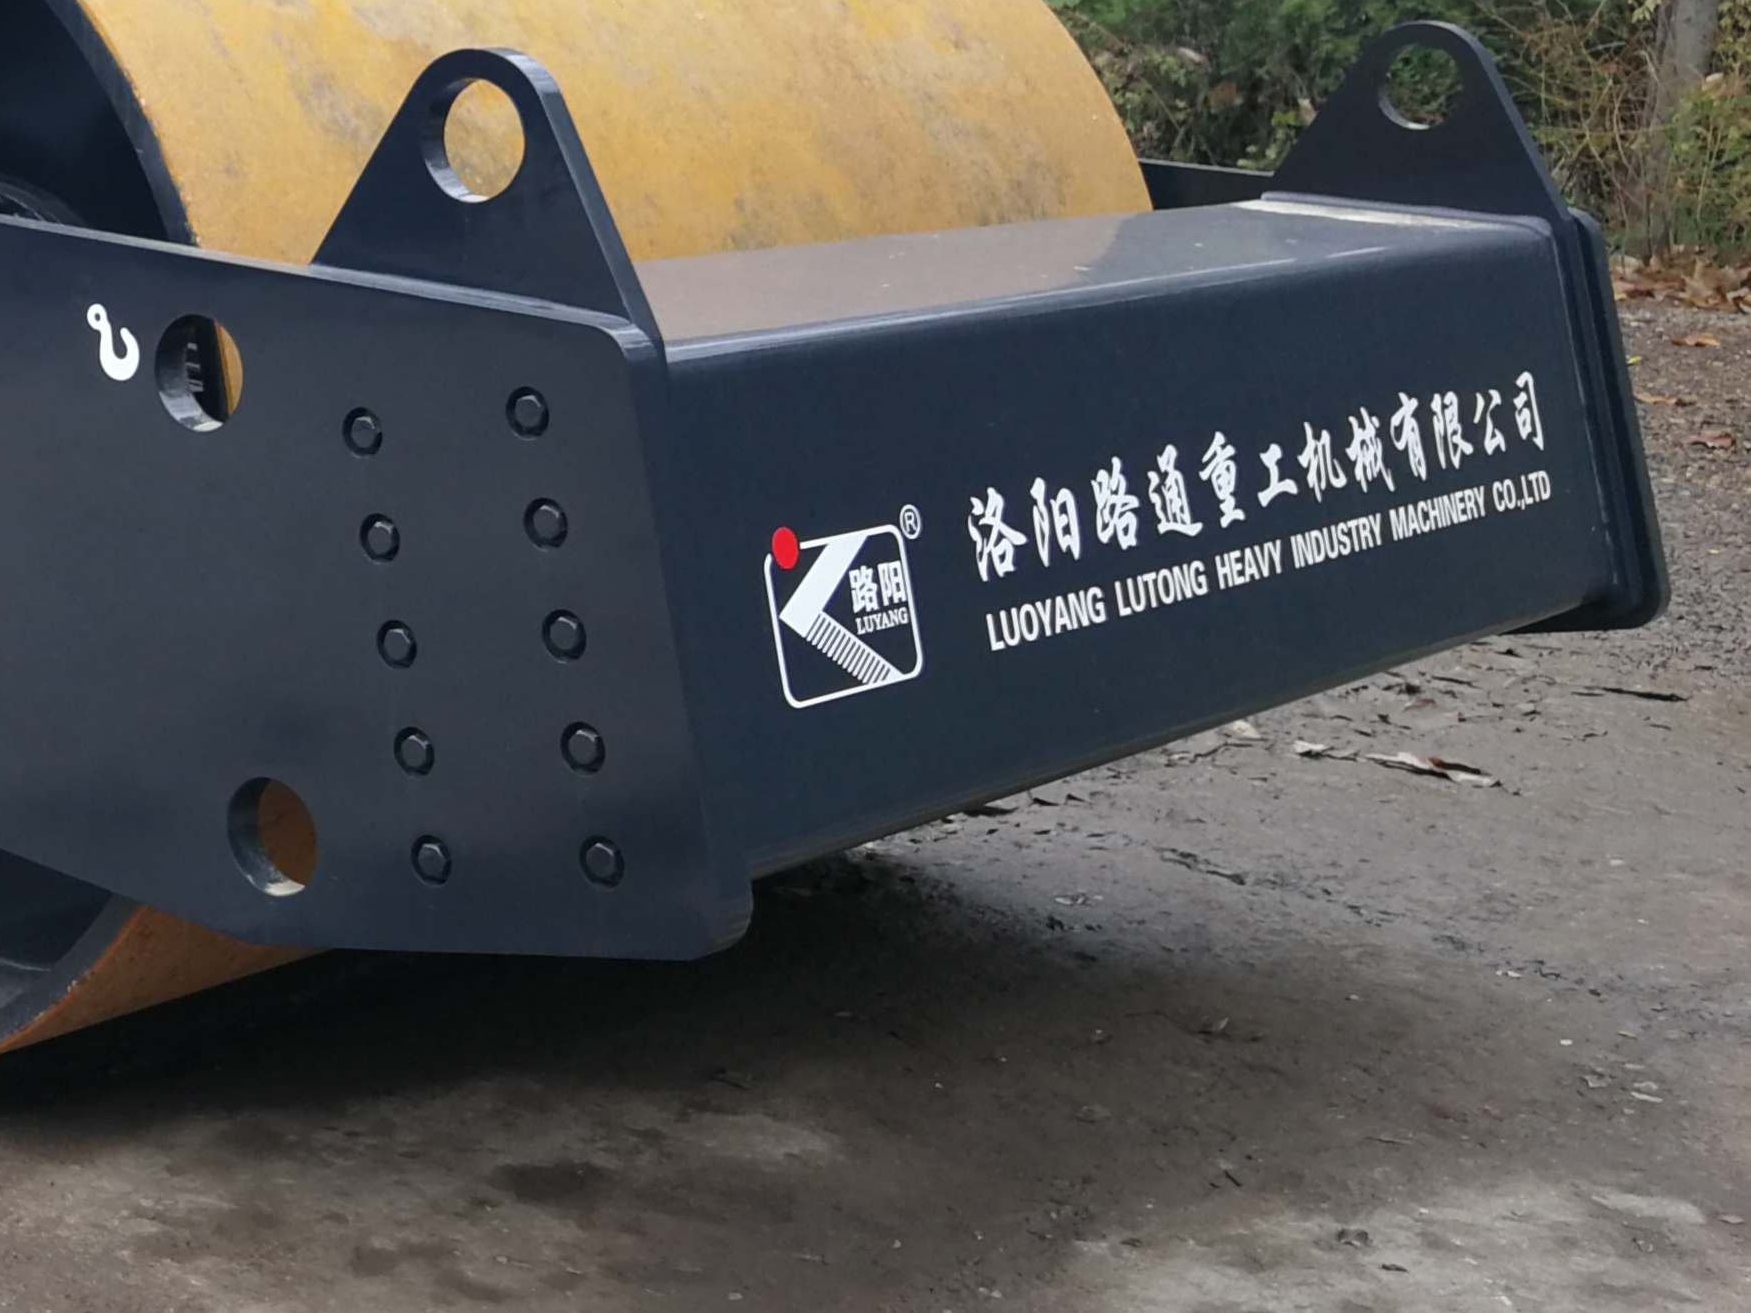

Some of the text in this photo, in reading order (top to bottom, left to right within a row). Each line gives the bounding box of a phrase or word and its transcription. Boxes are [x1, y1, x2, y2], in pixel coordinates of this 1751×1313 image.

[968, 371, 1545, 582] 洛阳路通重工机械有限公司
[849, 561, 907, 612] 路阳
[986, 471, 1551, 651] LUOYANG LUTONG HEAVY INDUSTRY MACHINERY CO.,LTD
[855, 607, 909, 635] LUYANG
